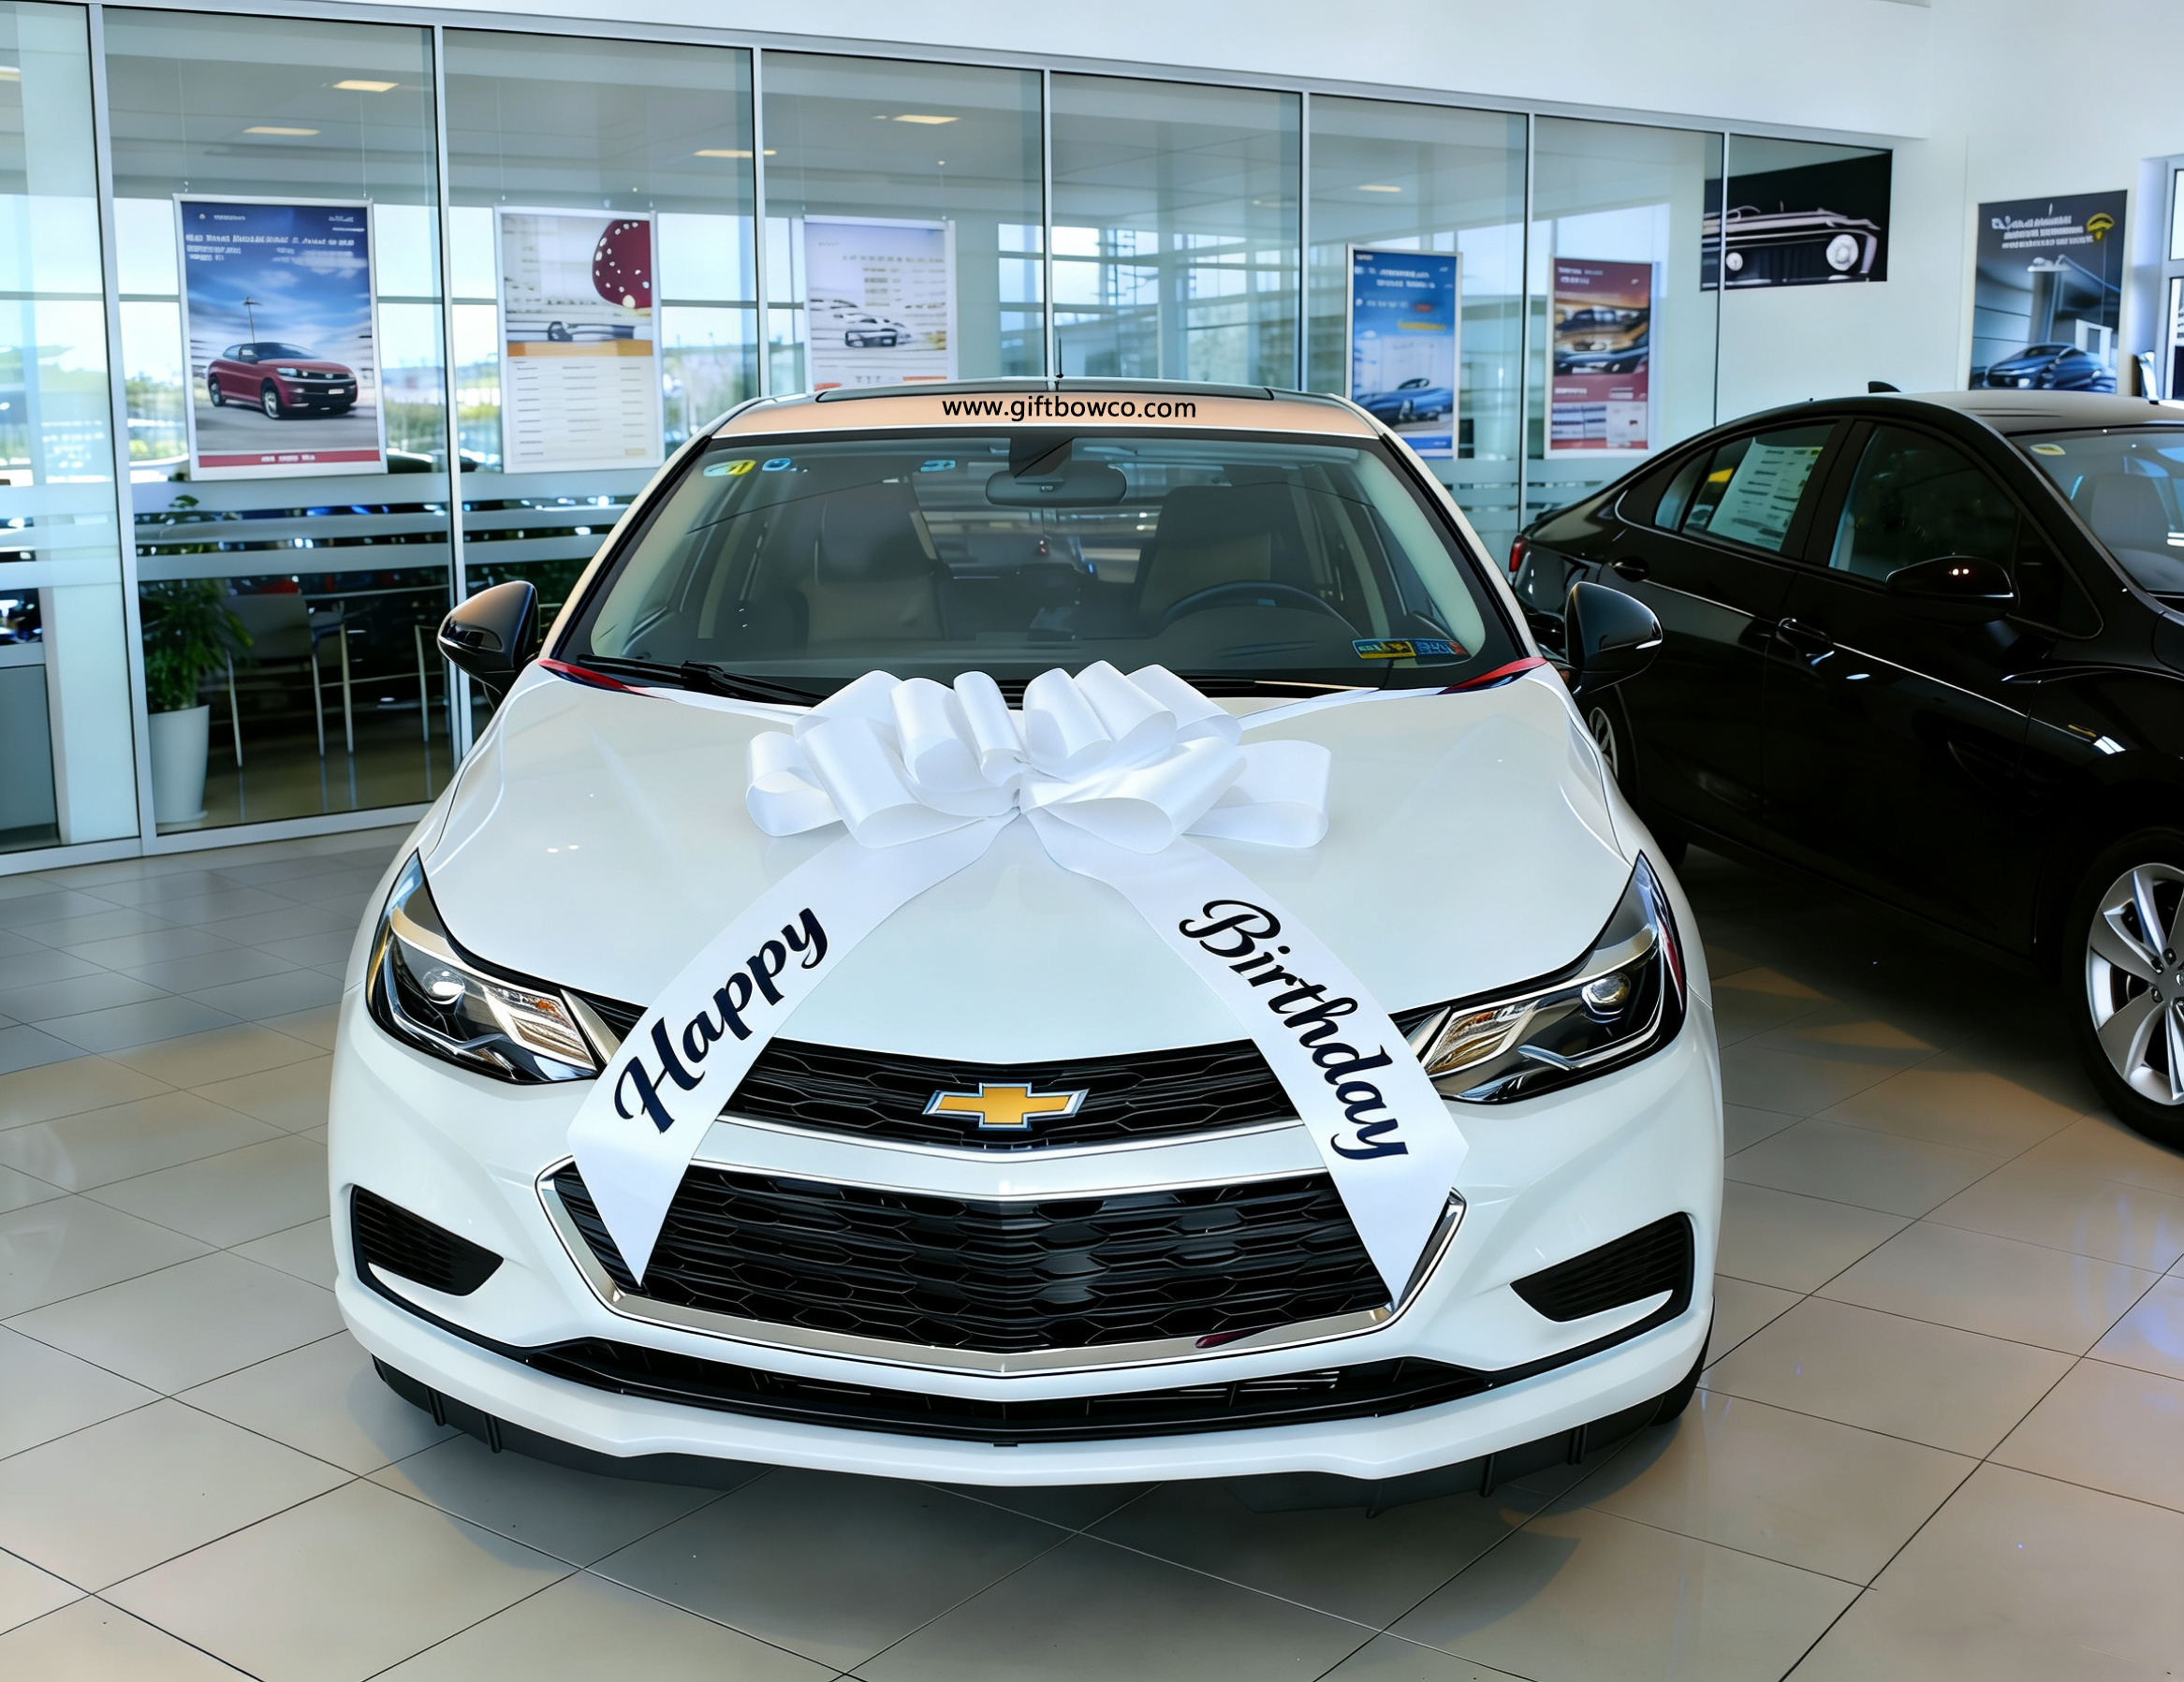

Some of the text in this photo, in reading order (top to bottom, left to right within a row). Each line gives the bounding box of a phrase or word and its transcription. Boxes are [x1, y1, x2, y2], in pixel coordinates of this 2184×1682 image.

[942, 395, 1196, 421] www.giftbowco.com
[614, 907, 828, 1134] Happy
[1179, 900, 1409, 1160] Birthday
